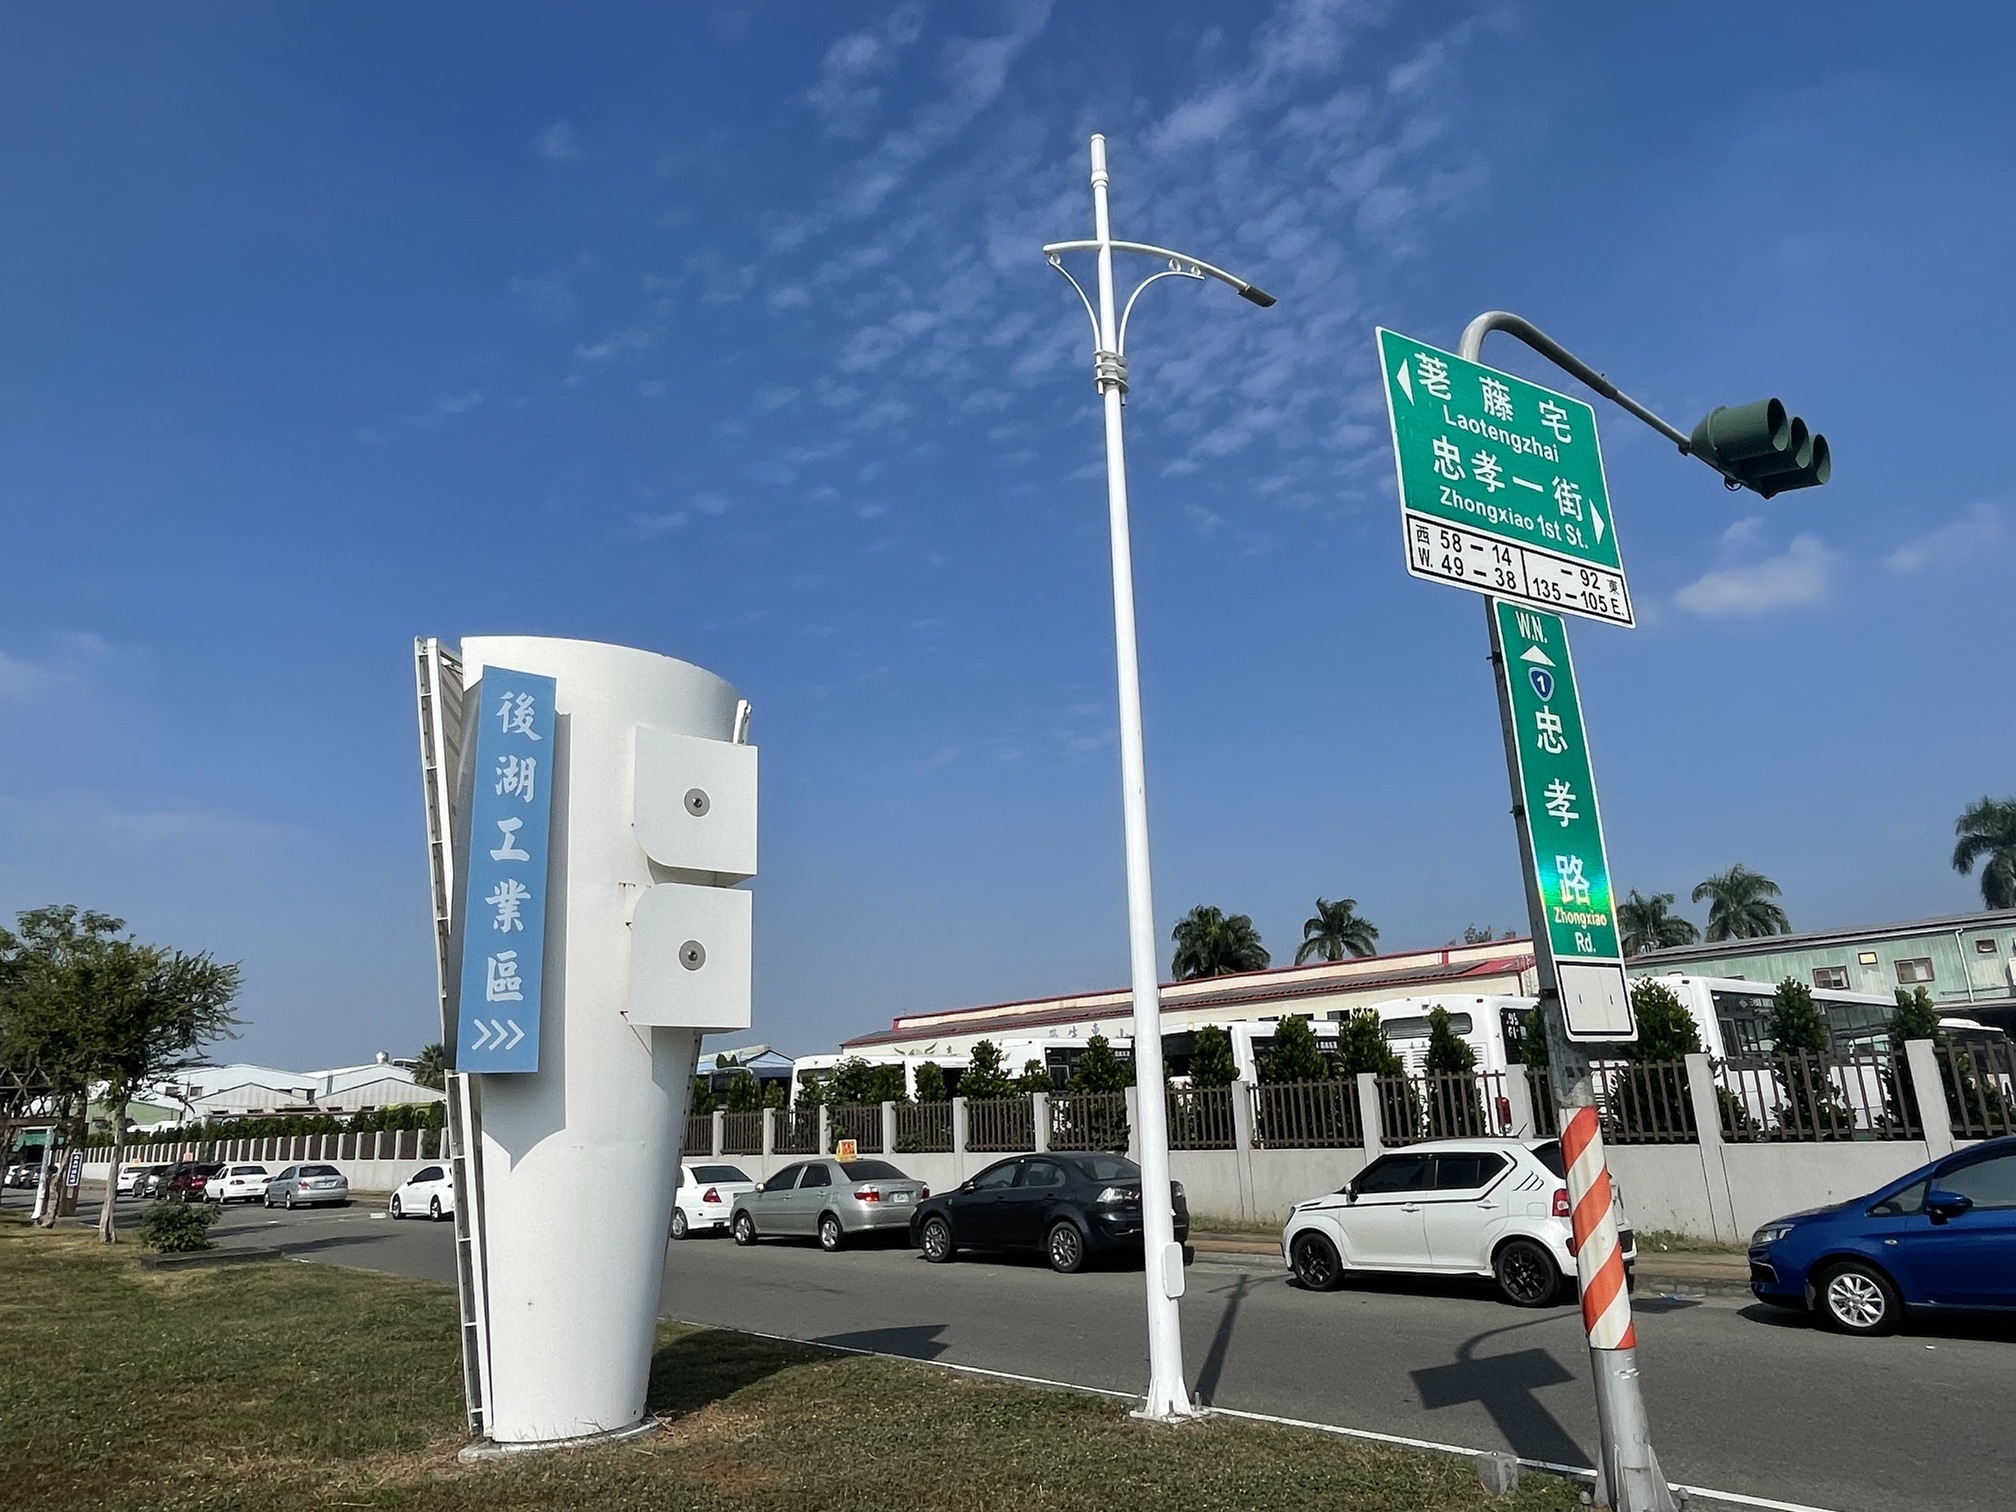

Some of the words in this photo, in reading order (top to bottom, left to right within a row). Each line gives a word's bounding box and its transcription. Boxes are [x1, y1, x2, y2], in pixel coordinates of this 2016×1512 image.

[1414, 352, 1572, 444] 荖藤宅
[1443, 404, 1560, 463] Laotengzhai
[1432, 435, 1583, 522] 忠孝一街
[1439, 485, 1534, 531] Zhongxiao
[1537, 517, 1562, 542] 1st
[1566, 524, 1589, 549] St.
[1415, 524, 1430, 545] 西
[1440, 529, 1462, 553] 58
[1492, 544, 1512, 566] 14
[1418, 546, 1433, 568] W.
[1441, 554, 1464, 577] 49
[1494, 567, 1517, 590] 38
[1580, 569, 1600, 590] 92
[1606, 579, 1620, 595] 東
[1515, 611, 1548, 643] W.N.
[1611, 598, 1625, 616] E.
[1537, 674, 1546, 693] 1
[1535, 704, 1591, 906] 忠孝路
[484, 690, 543, 1003] 後湖工業區
[1553, 906, 1607, 930] Zhongxiao
[1575, 931, 1596, 953] Rd.
